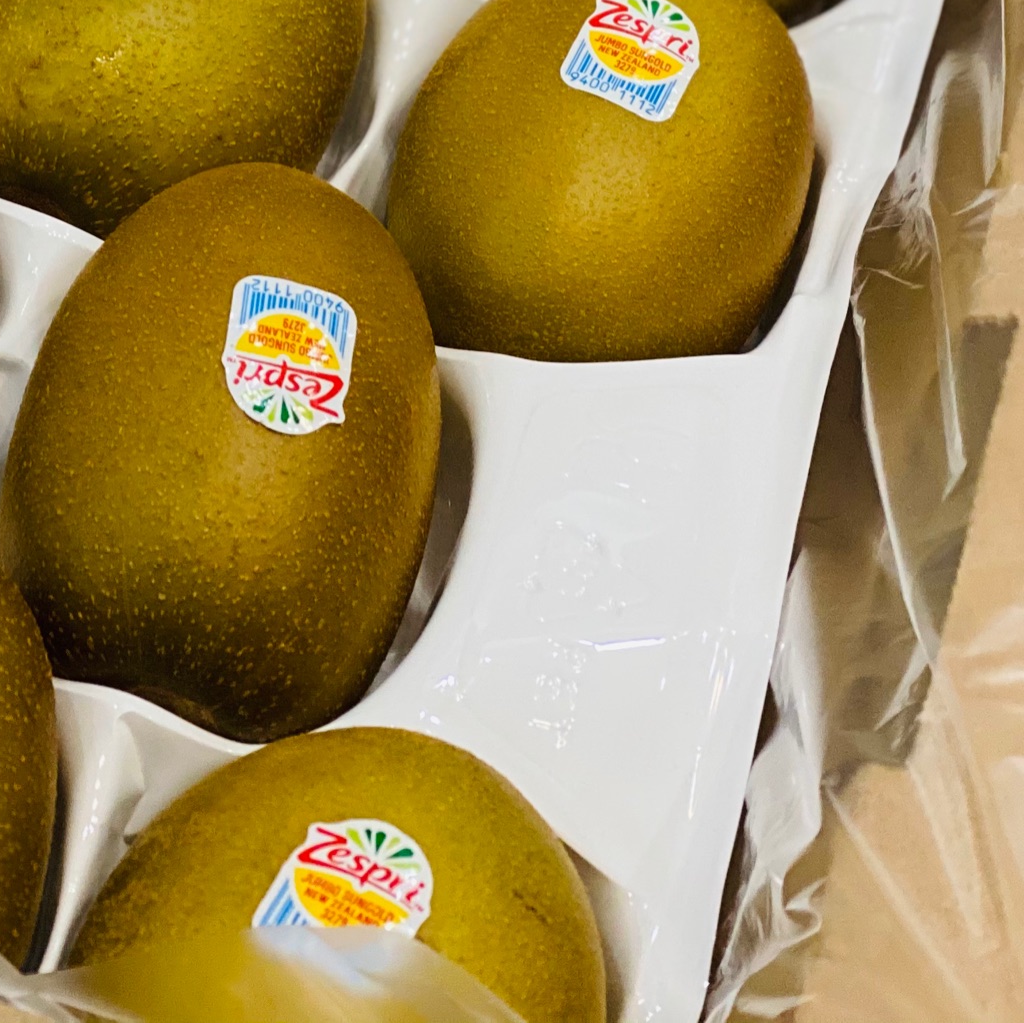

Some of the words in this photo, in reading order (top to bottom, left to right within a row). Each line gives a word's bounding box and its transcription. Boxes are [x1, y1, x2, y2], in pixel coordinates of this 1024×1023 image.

[595, 35, 628, 51] JUMBO
[630, 46, 672, 72] SUNGOLD
[598, 45, 619, 57] NEW
[621, 54, 661, 76] ZEALAND
[614, 60, 636, 75] 3279
[570, 71, 610, 93] 9400
[620, 90, 656, 115] 1112
[252, 279, 292, 297] 1112
[303, 290, 343, 313] 9400
[257, 324, 301, 343] ZEALAND
[282, 318, 306, 332] 3279
[248, 333, 296, 354] SUNGOLD
[305, 338, 326, 350] EW
[233, 355, 344, 417] Zespri
[298, 827, 425, 909] Zespri
[304, 888, 328, 904] NEW
[341, 888, 395, 922] SUNGOLD
